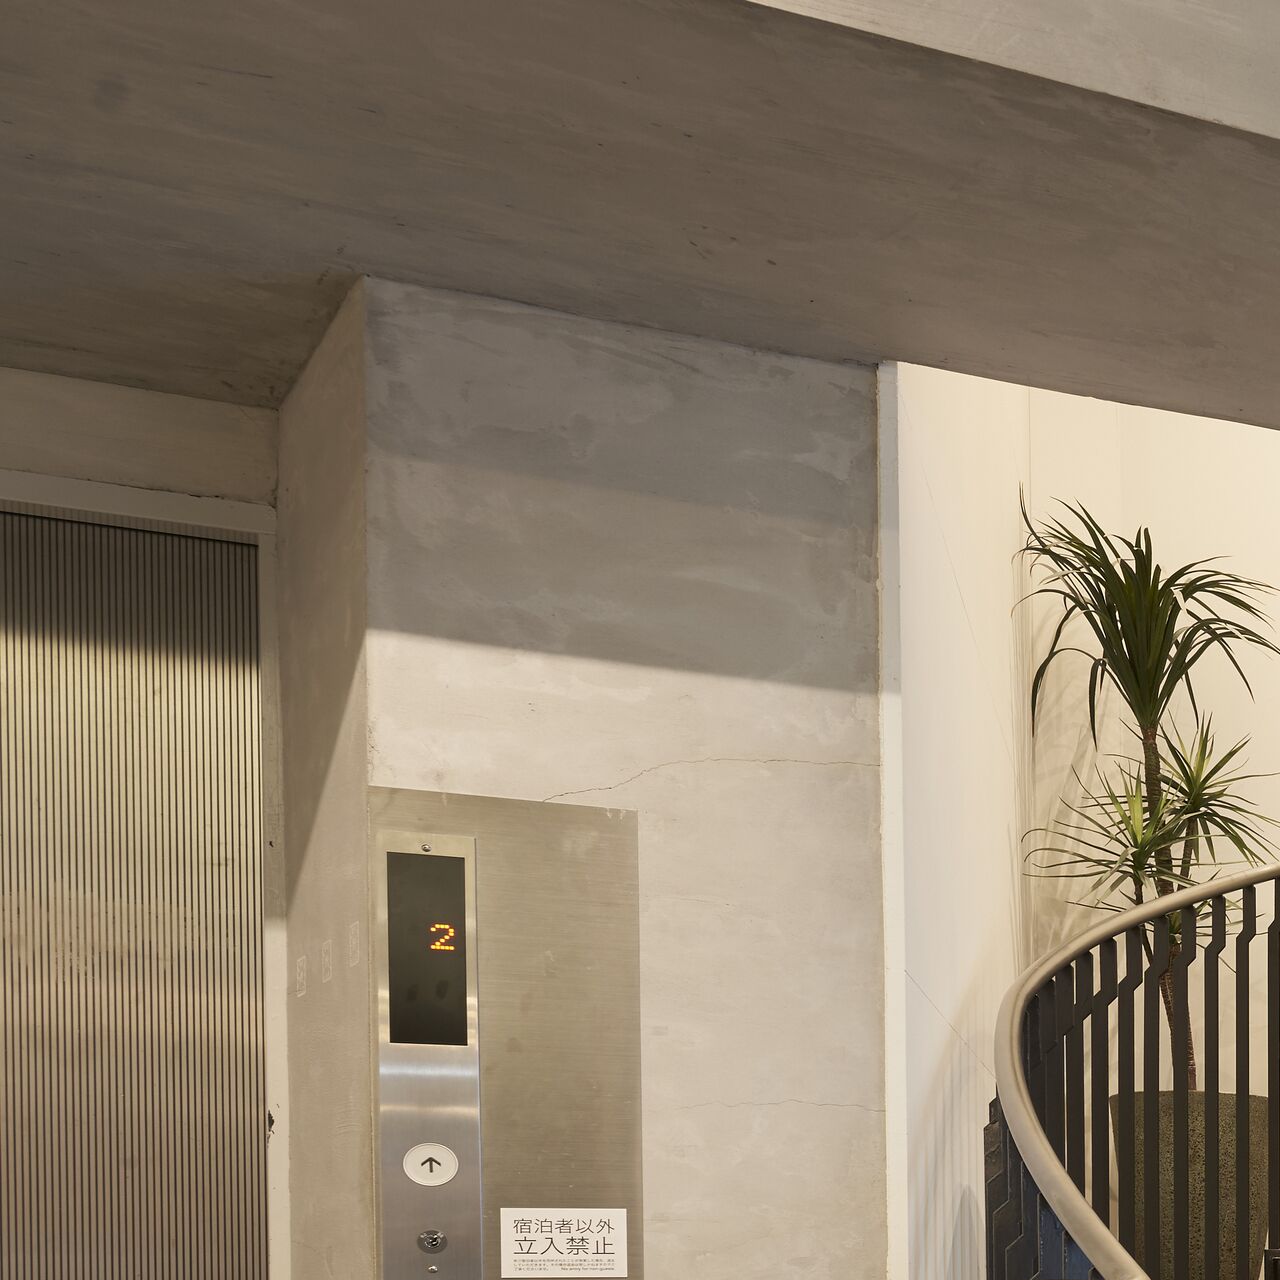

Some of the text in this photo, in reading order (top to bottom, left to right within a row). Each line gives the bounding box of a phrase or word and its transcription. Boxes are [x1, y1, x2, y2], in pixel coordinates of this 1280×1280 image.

[430, 923, 455, 951] 2
[513, 1218, 615, 1234] 宿泊者以外
[513, 1236, 615, 1255] 立入禁止
